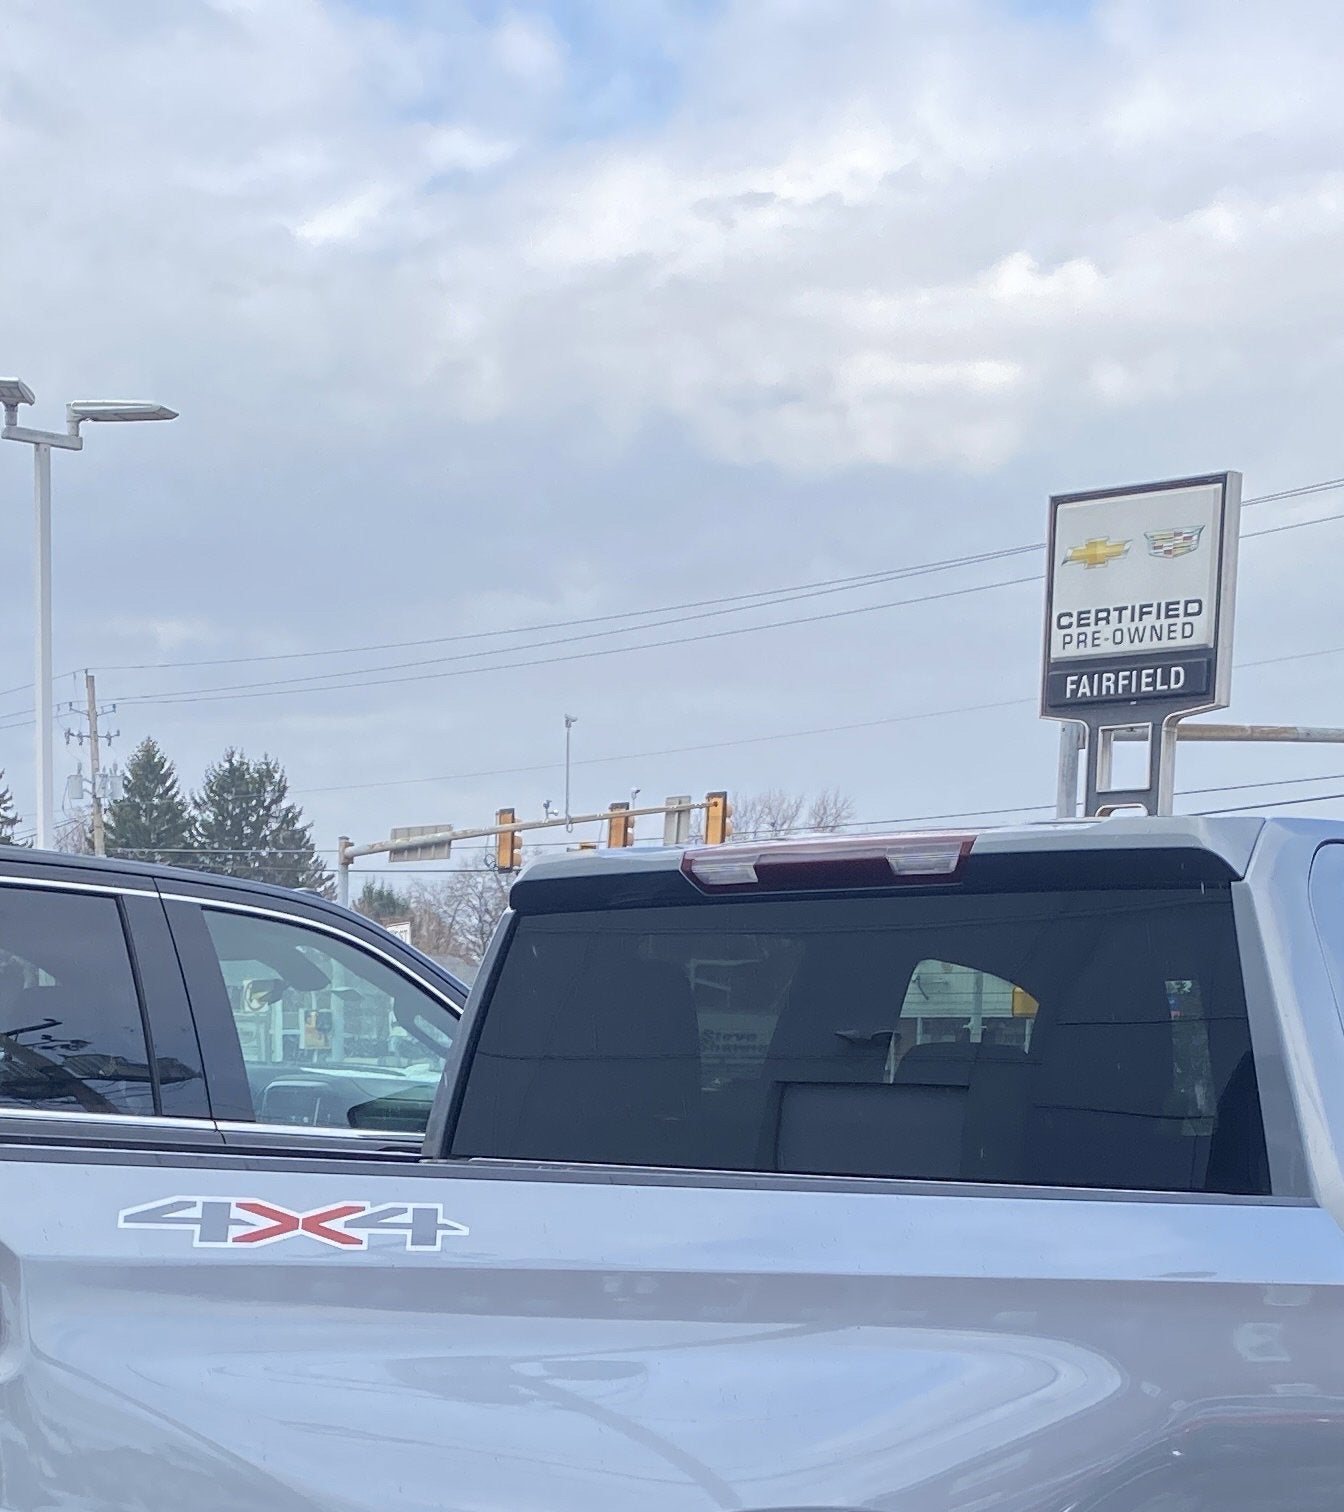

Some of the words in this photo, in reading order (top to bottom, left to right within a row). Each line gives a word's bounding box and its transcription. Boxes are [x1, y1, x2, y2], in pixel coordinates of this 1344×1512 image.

[1056, 598, 1203, 630] CERTIFIED
[1062, 621, 1195, 650] PRE-OWNED
[1065, 666, 1186, 699] FAIRFIELD
